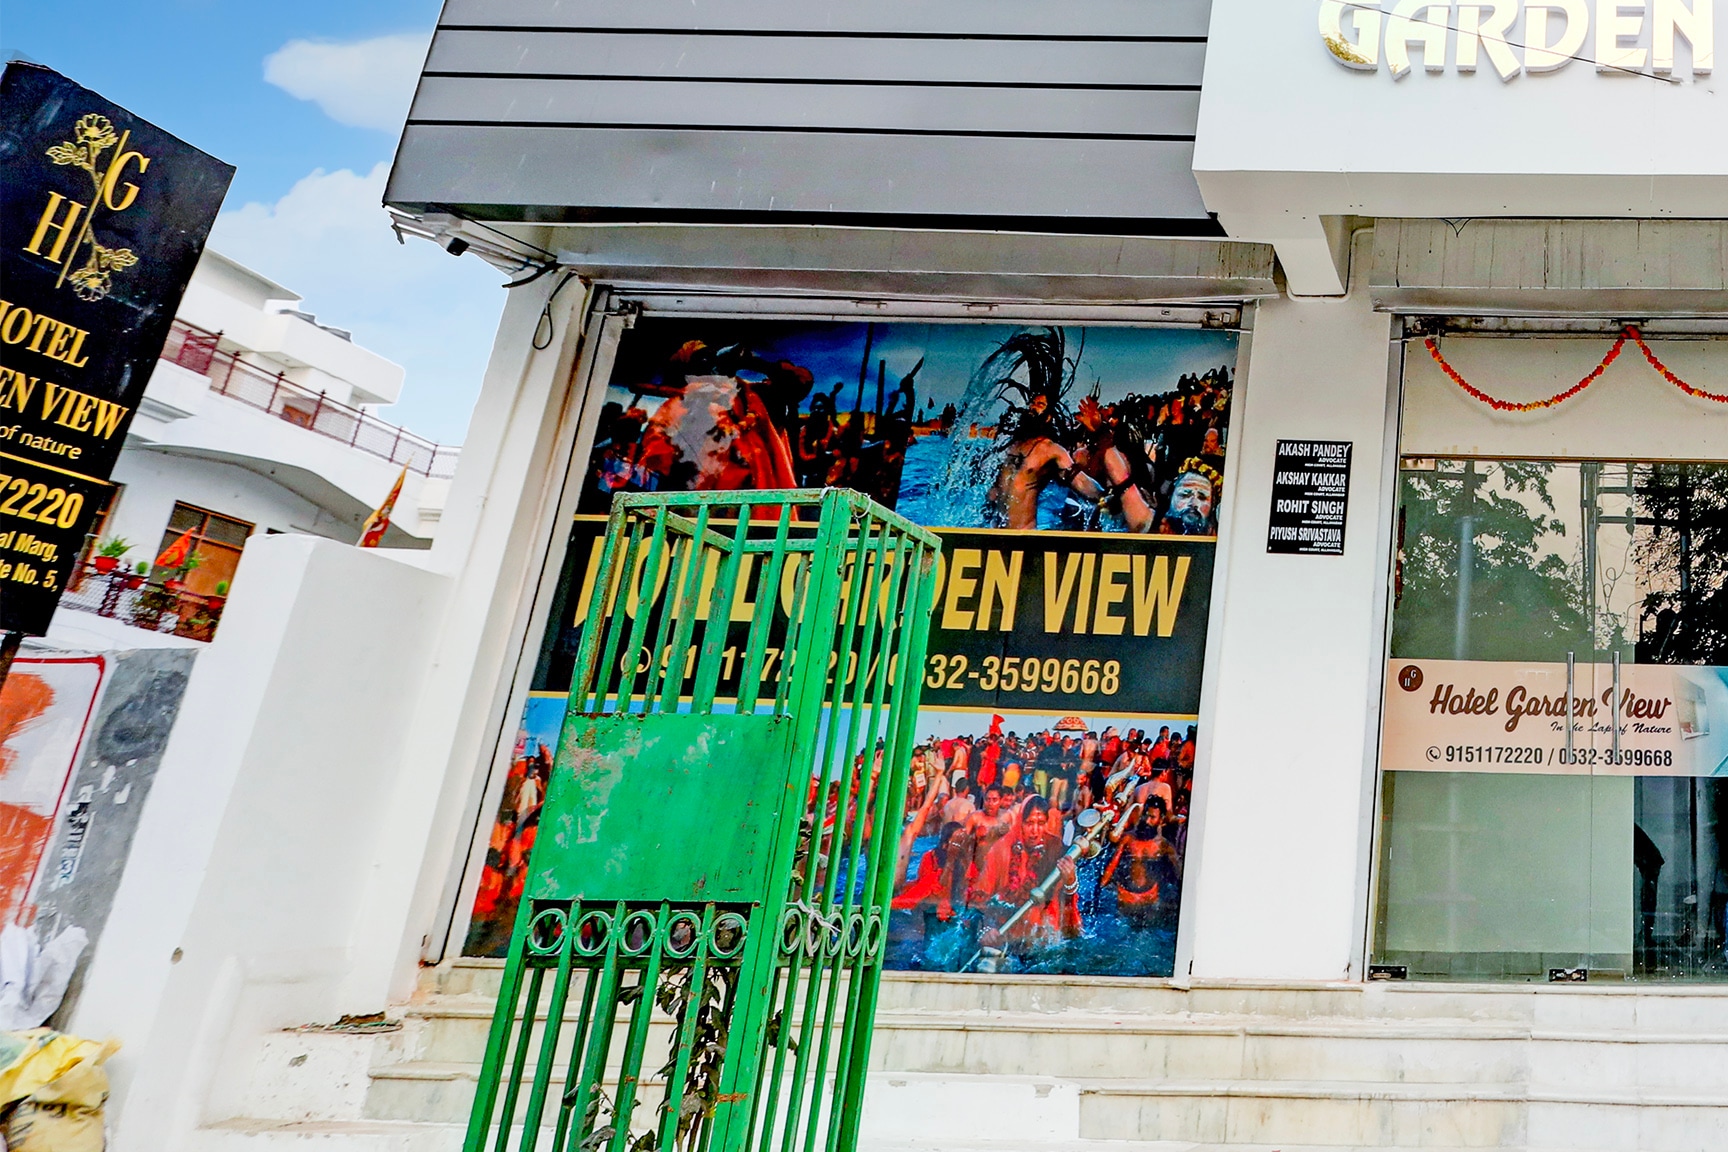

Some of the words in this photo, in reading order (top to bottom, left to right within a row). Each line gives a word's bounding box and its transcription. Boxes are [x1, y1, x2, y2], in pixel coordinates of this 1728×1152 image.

[0, 299, 91, 368] OTEL
[40, 382, 130, 440] VIEW
[18, 432, 83, 460] nature
[1278, 443, 1310, 457] AKASH
[1312, 444, 1349, 458] PANDEY
[1276, 471, 1311, 486] AKSHAY
[1311, 472, 1346, 487] KAKKAR
[1276, 499, 1309, 514] ROHIT
[1311, 500, 1345, 515] SINGH
[13, 532, 59, 562] Marg,
[1270, 526, 1298, 541] PIYUSH
[1298, 527, 1342, 542] SRIVASTAVA
[11, 562, 39, 585] No.
[42, 569, 59, 592] 5,
[1043, 551, 1192, 637] VIEW
[888, 650, 1121, 695] 032-3599668
[1430, 684, 1499, 716] Hotel
[1504, 685, 1598, 733] Garden
[1602, 686, 1672, 719] View
[1550, 721, 1564, 732] In
[1587, 721, 1612, 735] Lap
[1632, 722, 1673, 734] Nature
[1445, 745, 1543, 764] 9151172220
